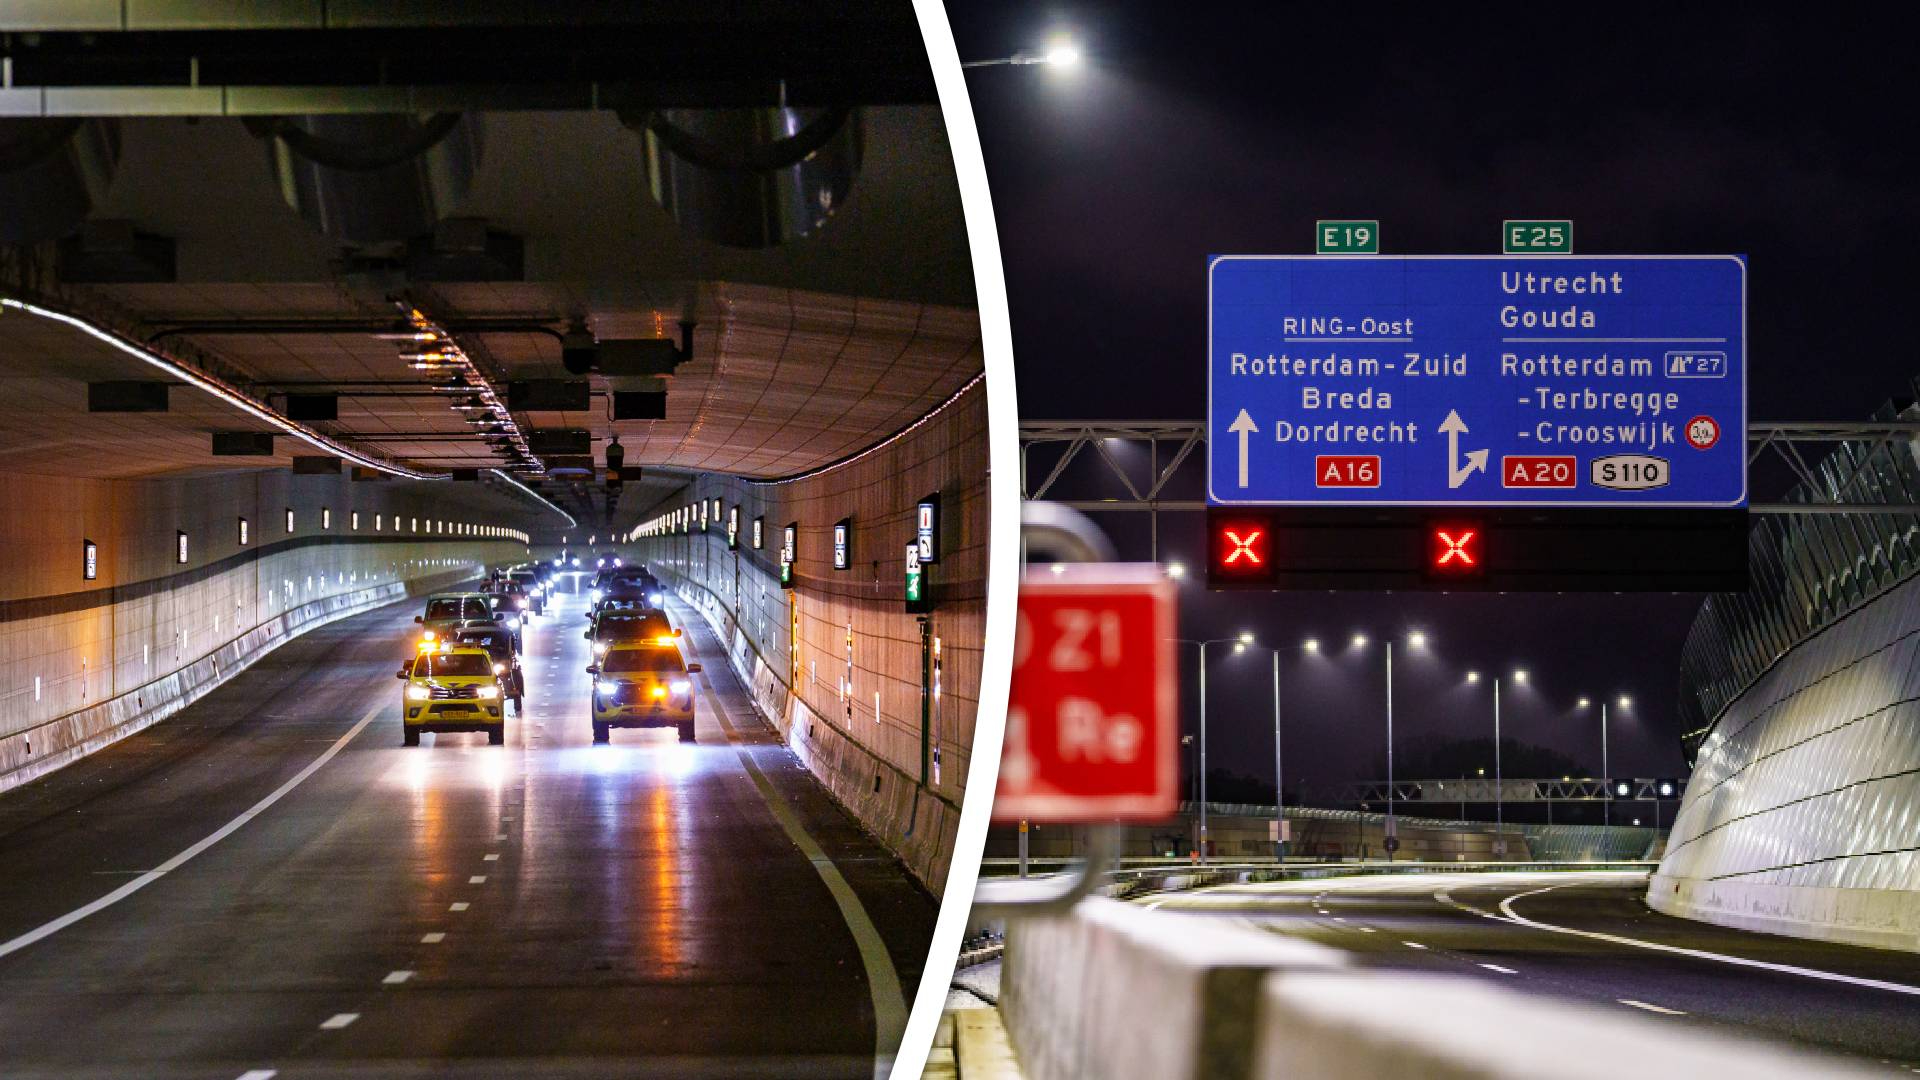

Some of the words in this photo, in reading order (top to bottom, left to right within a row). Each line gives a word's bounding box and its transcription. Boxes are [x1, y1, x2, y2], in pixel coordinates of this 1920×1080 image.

[1324, 227, 1370, 247] E19
[1511, 227, 1565, 247] E25
[1502, 271, 1623, 294] Utrecht
[1283, 317, 1414, 335] RING-Oost
[1500, 305, 1596, 328] Gouda
[1502, 353, 1653, 377] Rotterdam
[1696, 358, 1721, 372] 27
[1303, 387, 1392, 409] Breda
[1519, 388, 1679, 416] -Terbregge
[1275, 420, 1418, 442] Dordrecht
[1519, 422, 1675, 450] -Crooswijk
[1324, 463, 1373, 482] A16
[1512, 463, 1569, 482] A20
[1602, 463, 1659, 482] S110
[1056, 696, 1143, 763] Re
